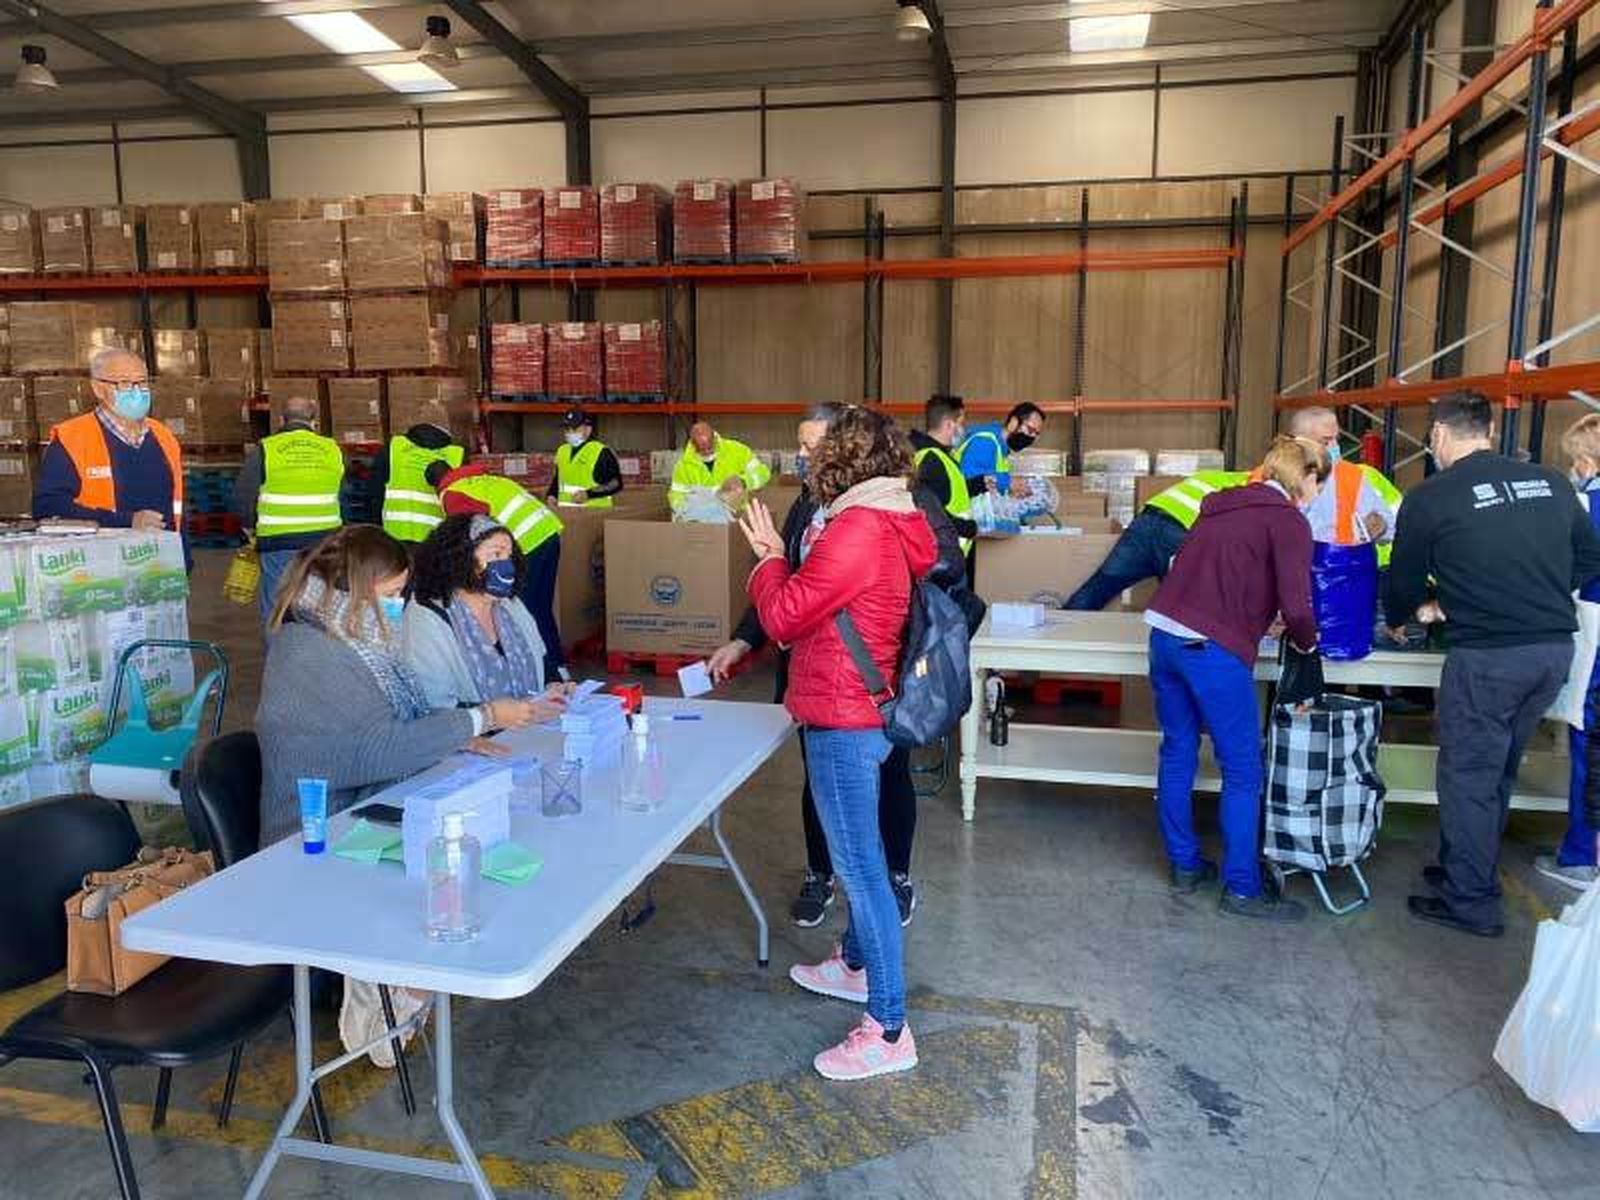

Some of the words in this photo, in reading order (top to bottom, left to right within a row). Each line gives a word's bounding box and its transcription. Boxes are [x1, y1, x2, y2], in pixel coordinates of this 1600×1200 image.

[38, 547, 86, 569] Lauki
[121, 540, 159, 561] Lauki
[54, 687, 98, 714] Lauki
